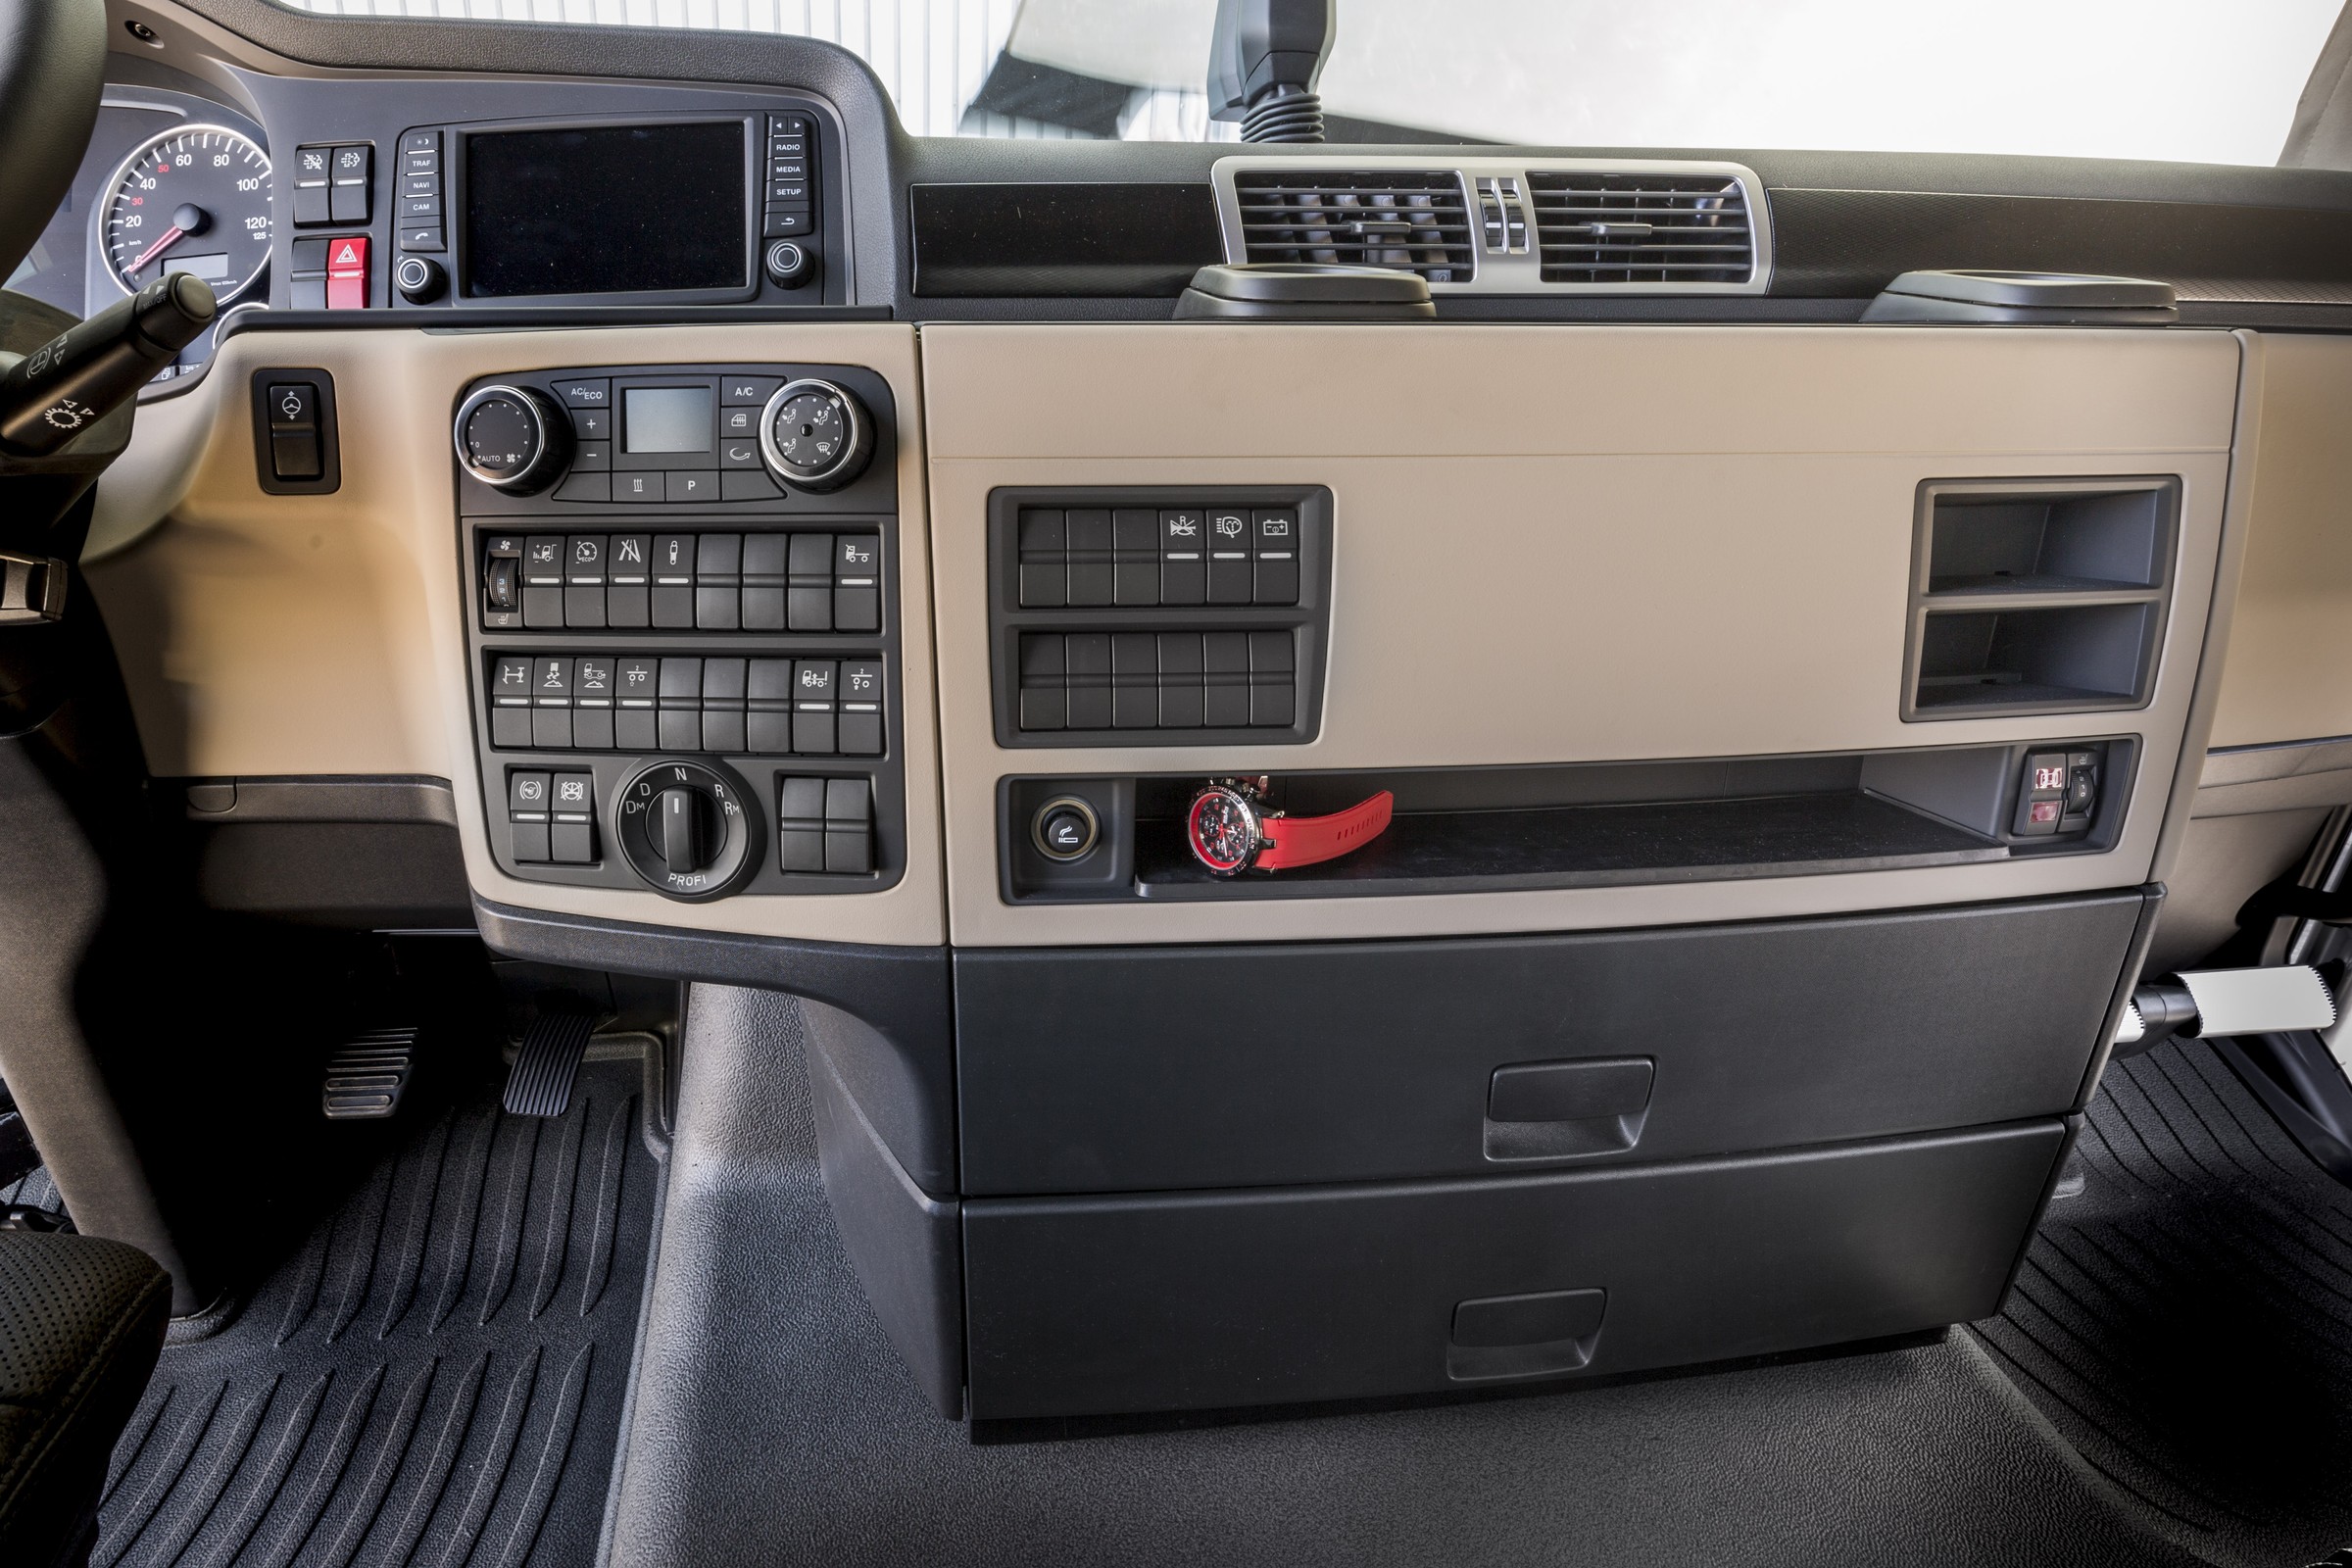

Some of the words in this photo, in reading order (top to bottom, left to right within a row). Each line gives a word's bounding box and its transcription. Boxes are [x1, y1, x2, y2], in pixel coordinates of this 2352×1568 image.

[175, 154, 192, 167] 60
[213, 154, 229, 167] 80
[158, 165, 170, 173] 50
[139, 177, 157, 190] 40
[236, 177, 259, 191] 100
[131, 197, 144, 206] 30
[125, 215, 142, 227] 20
[245, 217, 267, 229] 120
[735, 387, 754, 397] A/C
[688, 480, 696, 491] P
[674, 767, 687, 781] N
[640, 783, 651, 796] D
[714, 784, 724, 798] R
[667, 873, 707, 886] PROFI
